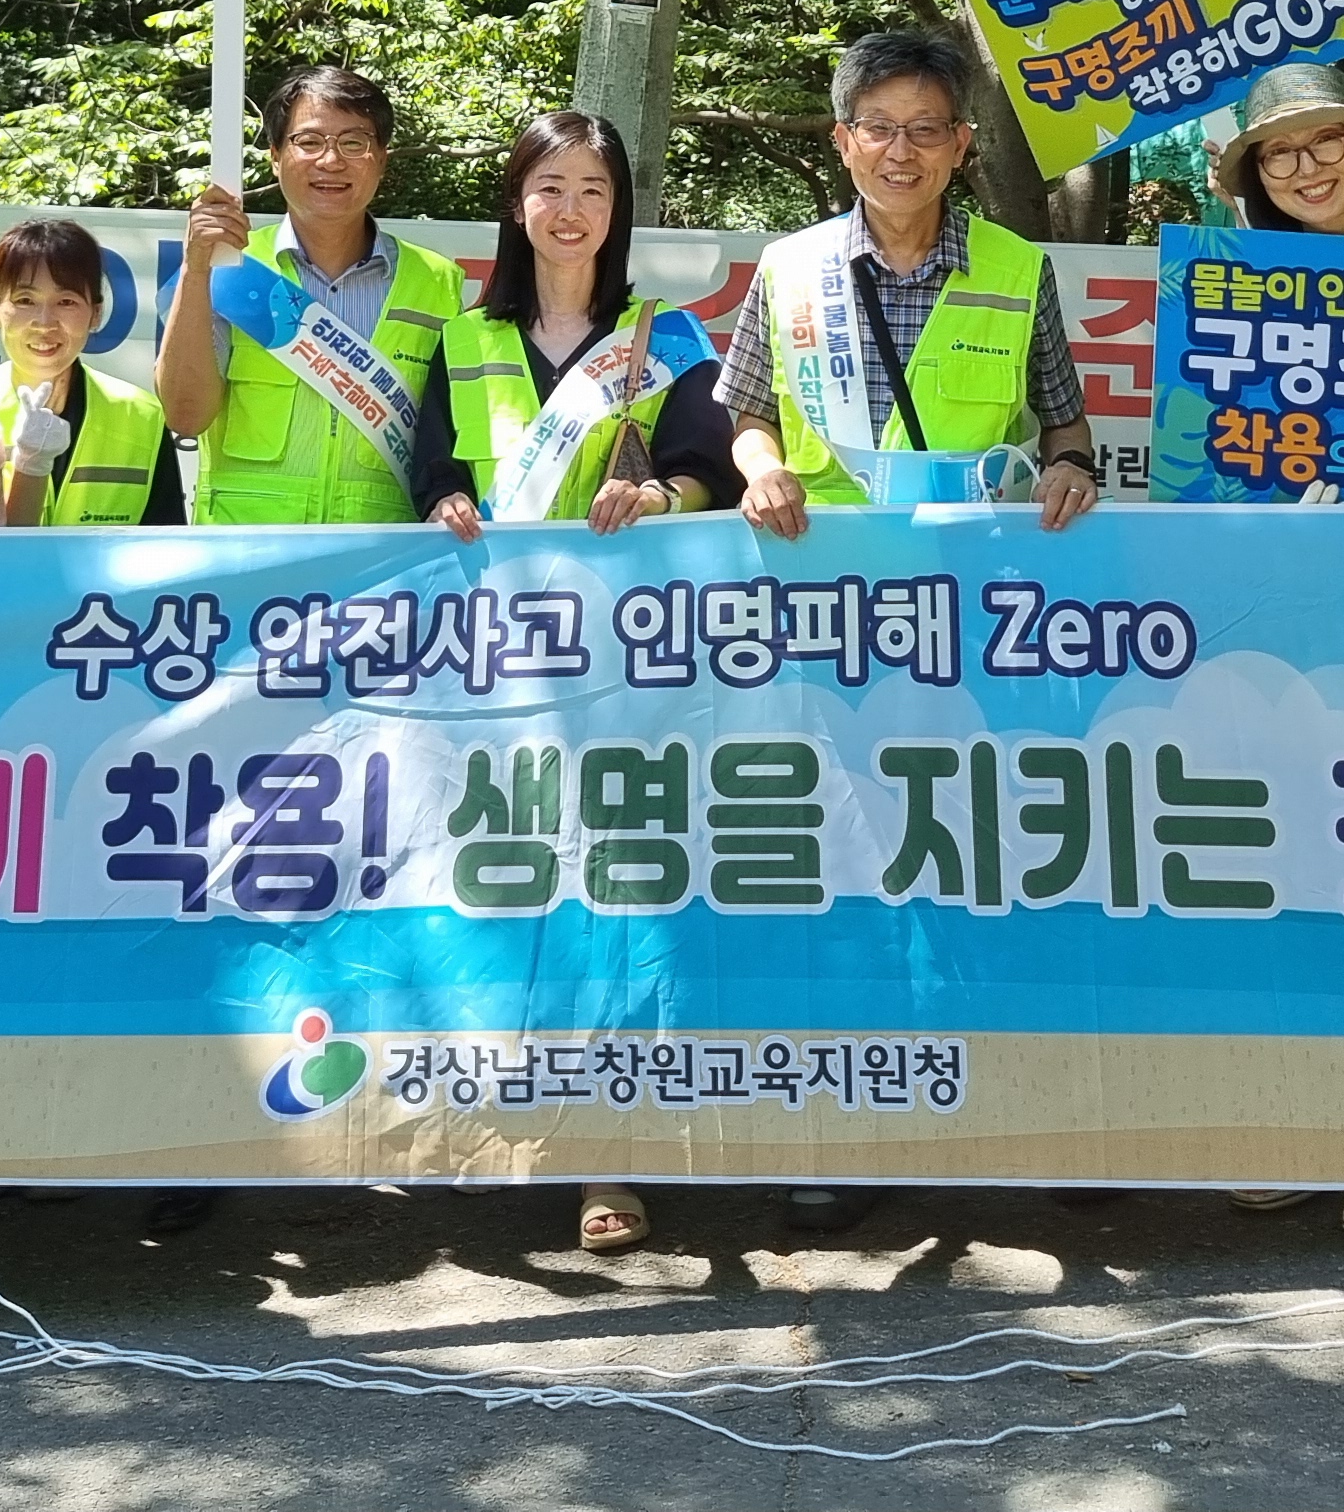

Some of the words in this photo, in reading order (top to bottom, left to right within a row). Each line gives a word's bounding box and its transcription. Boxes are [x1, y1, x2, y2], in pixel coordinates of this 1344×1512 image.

[1190, 262, 1305, 313] 물놀이
[290, 339, 388, 429] 가족사랑의
[311, 317, 376, 373] 안전한
[823, 303, 855, 404] 물놀이!
[53, 594, 222, 694] 수상
[257, 591, 585, 695] 안전사고
[619, 578, 953, 686] 인명피해
[987, 583, 1192, 676] Zero
[102, 751, 389, 913] 착용!
[452, 741, 826, 907] 생명을
[878, 740, 1276, 909] 지키는
[387, 1040, 962, 1108] 경상남도창원교육지원청
